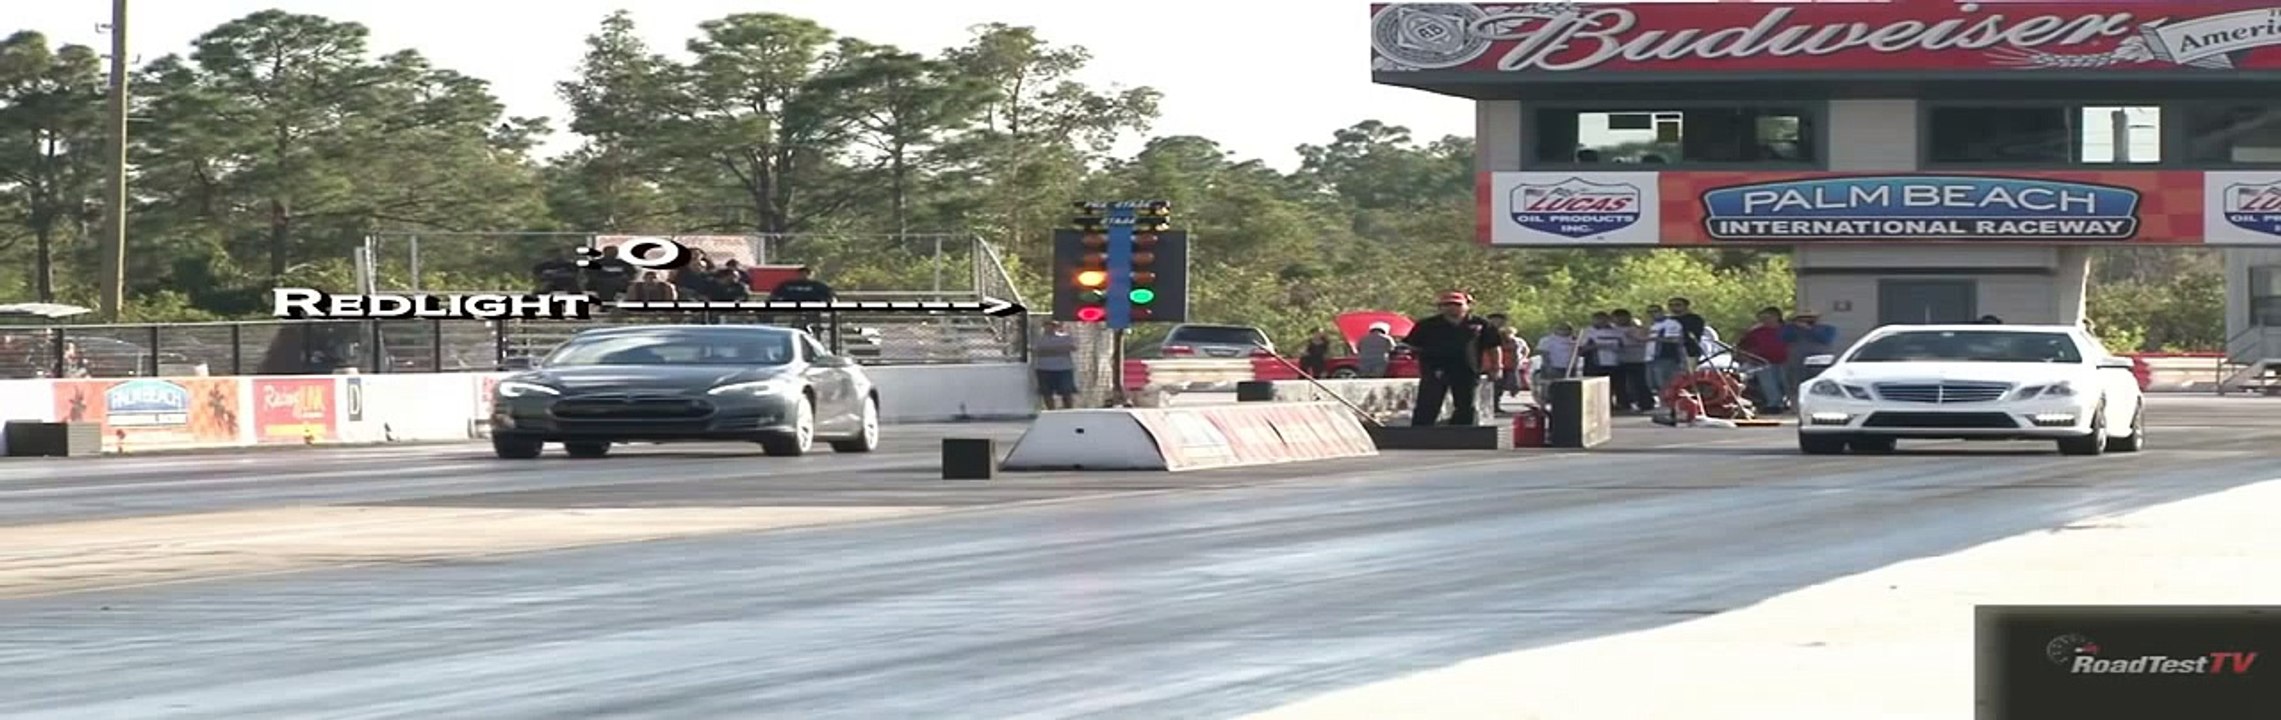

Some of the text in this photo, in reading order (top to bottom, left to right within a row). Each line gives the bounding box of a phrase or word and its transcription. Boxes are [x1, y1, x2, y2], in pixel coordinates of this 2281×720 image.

[1469, 3, 2133, 70] Budweiser
[1526, 198, 1633, 211] LUCAS
[1744, 185, 2095, 213] PALM BEACH
[1517, 214, 1634, 223] OIL PRODUCTS
[1720, 219, 2123, 235] INTERNATIONAL RACEWAY
